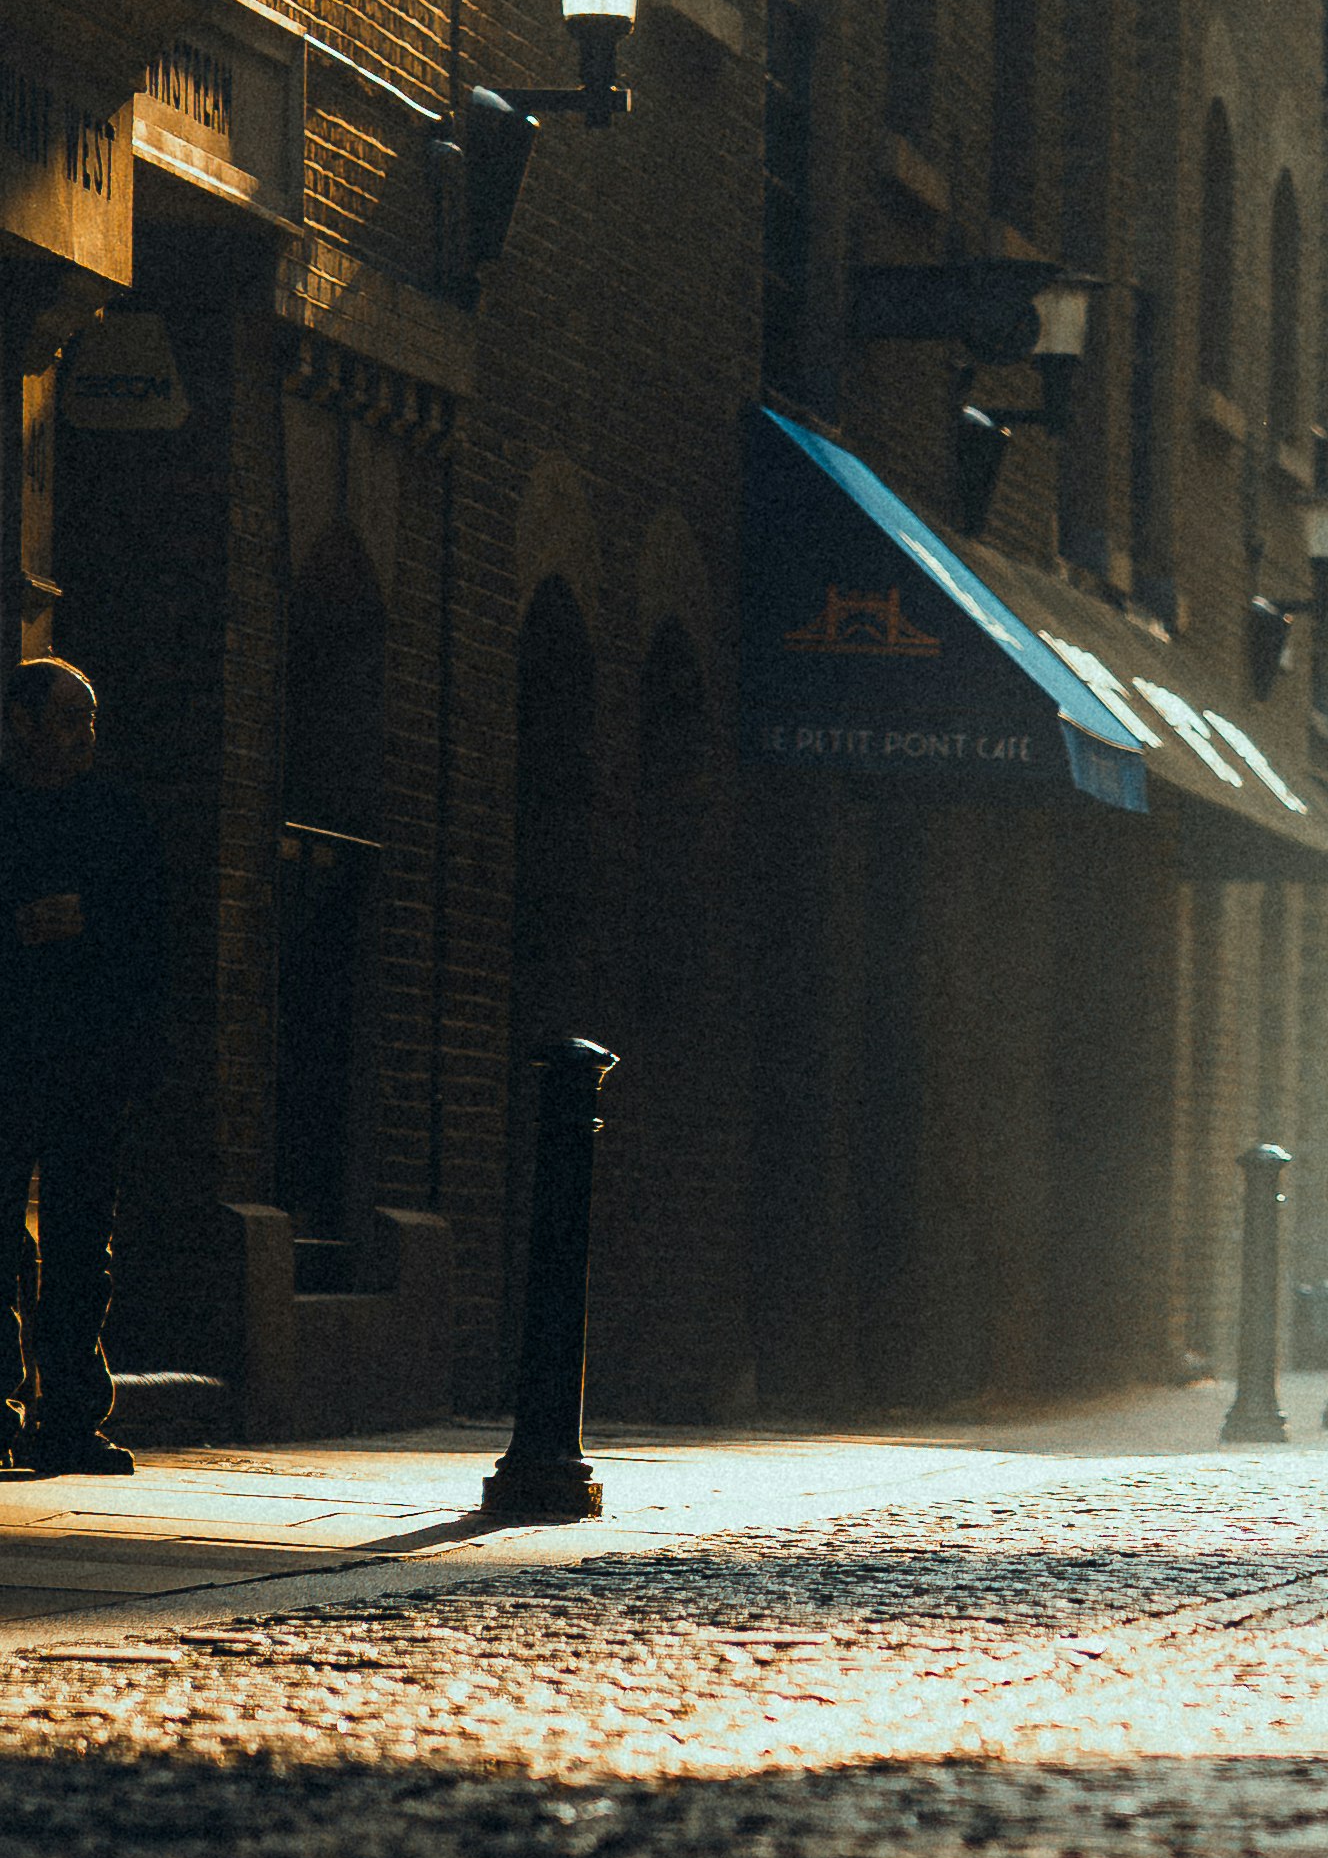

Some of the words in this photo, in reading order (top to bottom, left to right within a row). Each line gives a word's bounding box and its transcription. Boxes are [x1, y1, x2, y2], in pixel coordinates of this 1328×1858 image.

[66, 101, 115, 202] WEST
[795, 727, 873, 755] PETIT
[884, 730, 966, 759] PONT
